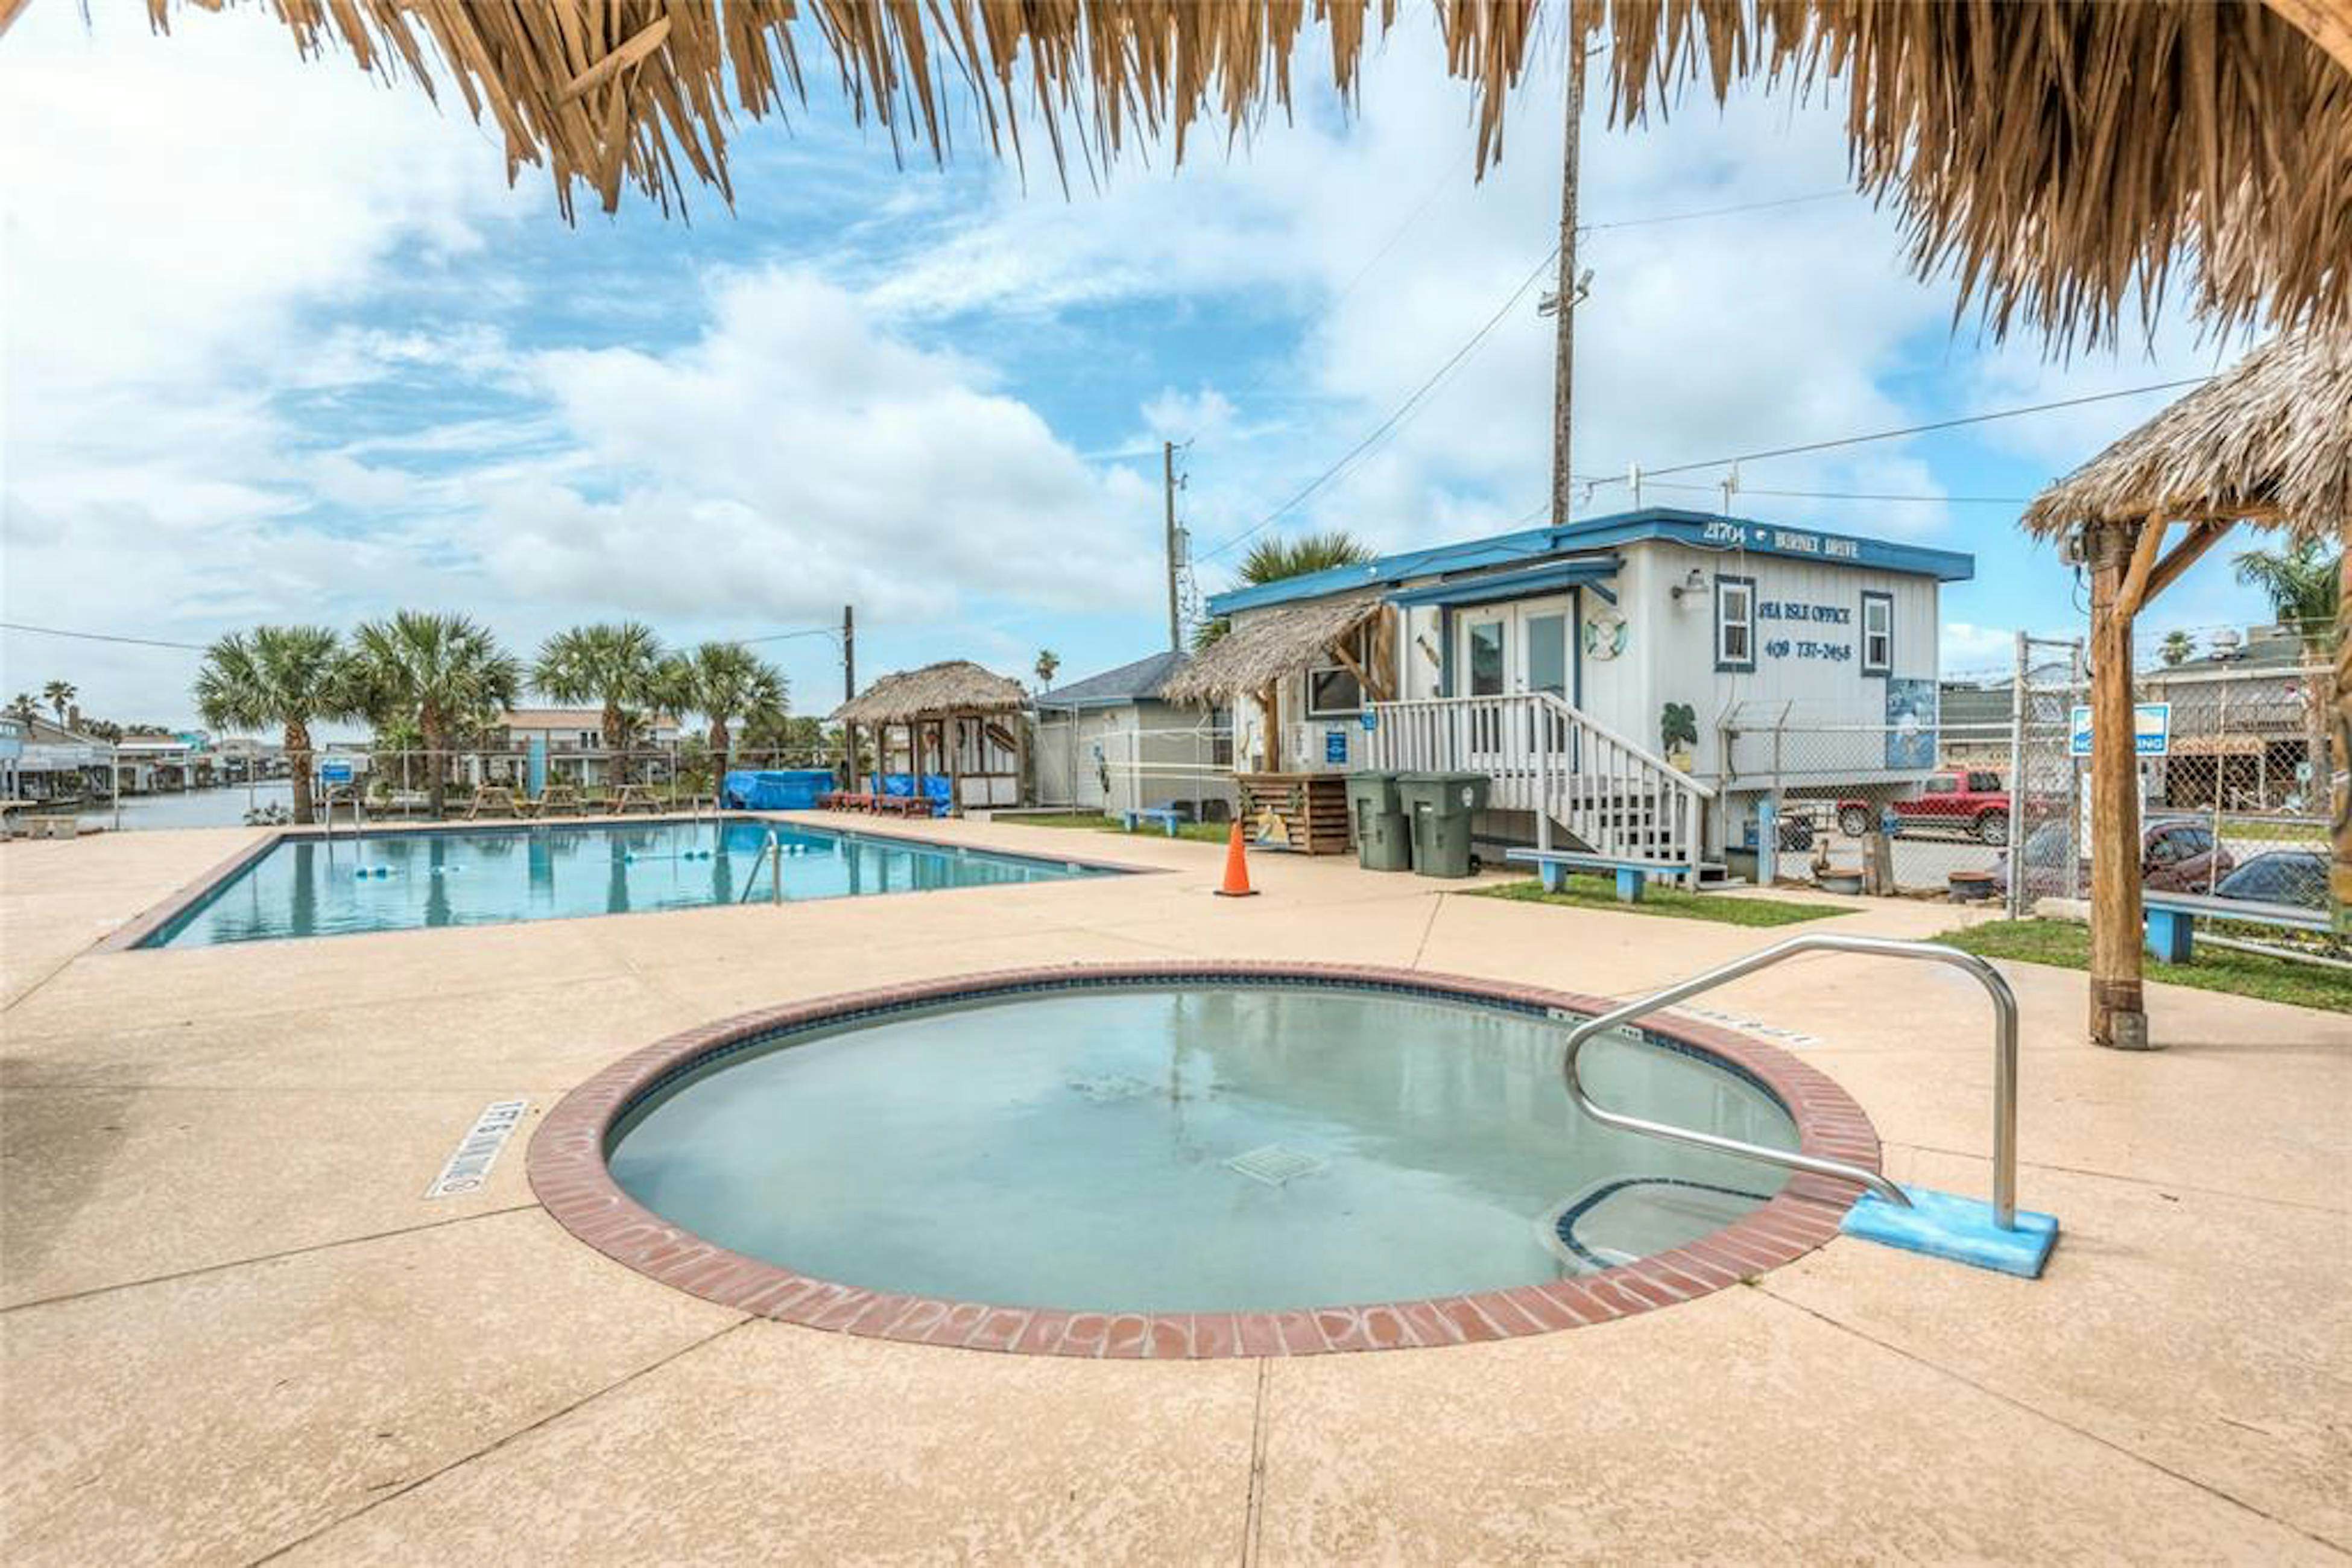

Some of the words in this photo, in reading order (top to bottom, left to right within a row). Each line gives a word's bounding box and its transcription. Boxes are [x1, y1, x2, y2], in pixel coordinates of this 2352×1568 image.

[1759, 602, 1781, 619] SEA
[1785, 603, 1809, 620] ISLE
[1812, 605, 1851, 624] OFFICE
